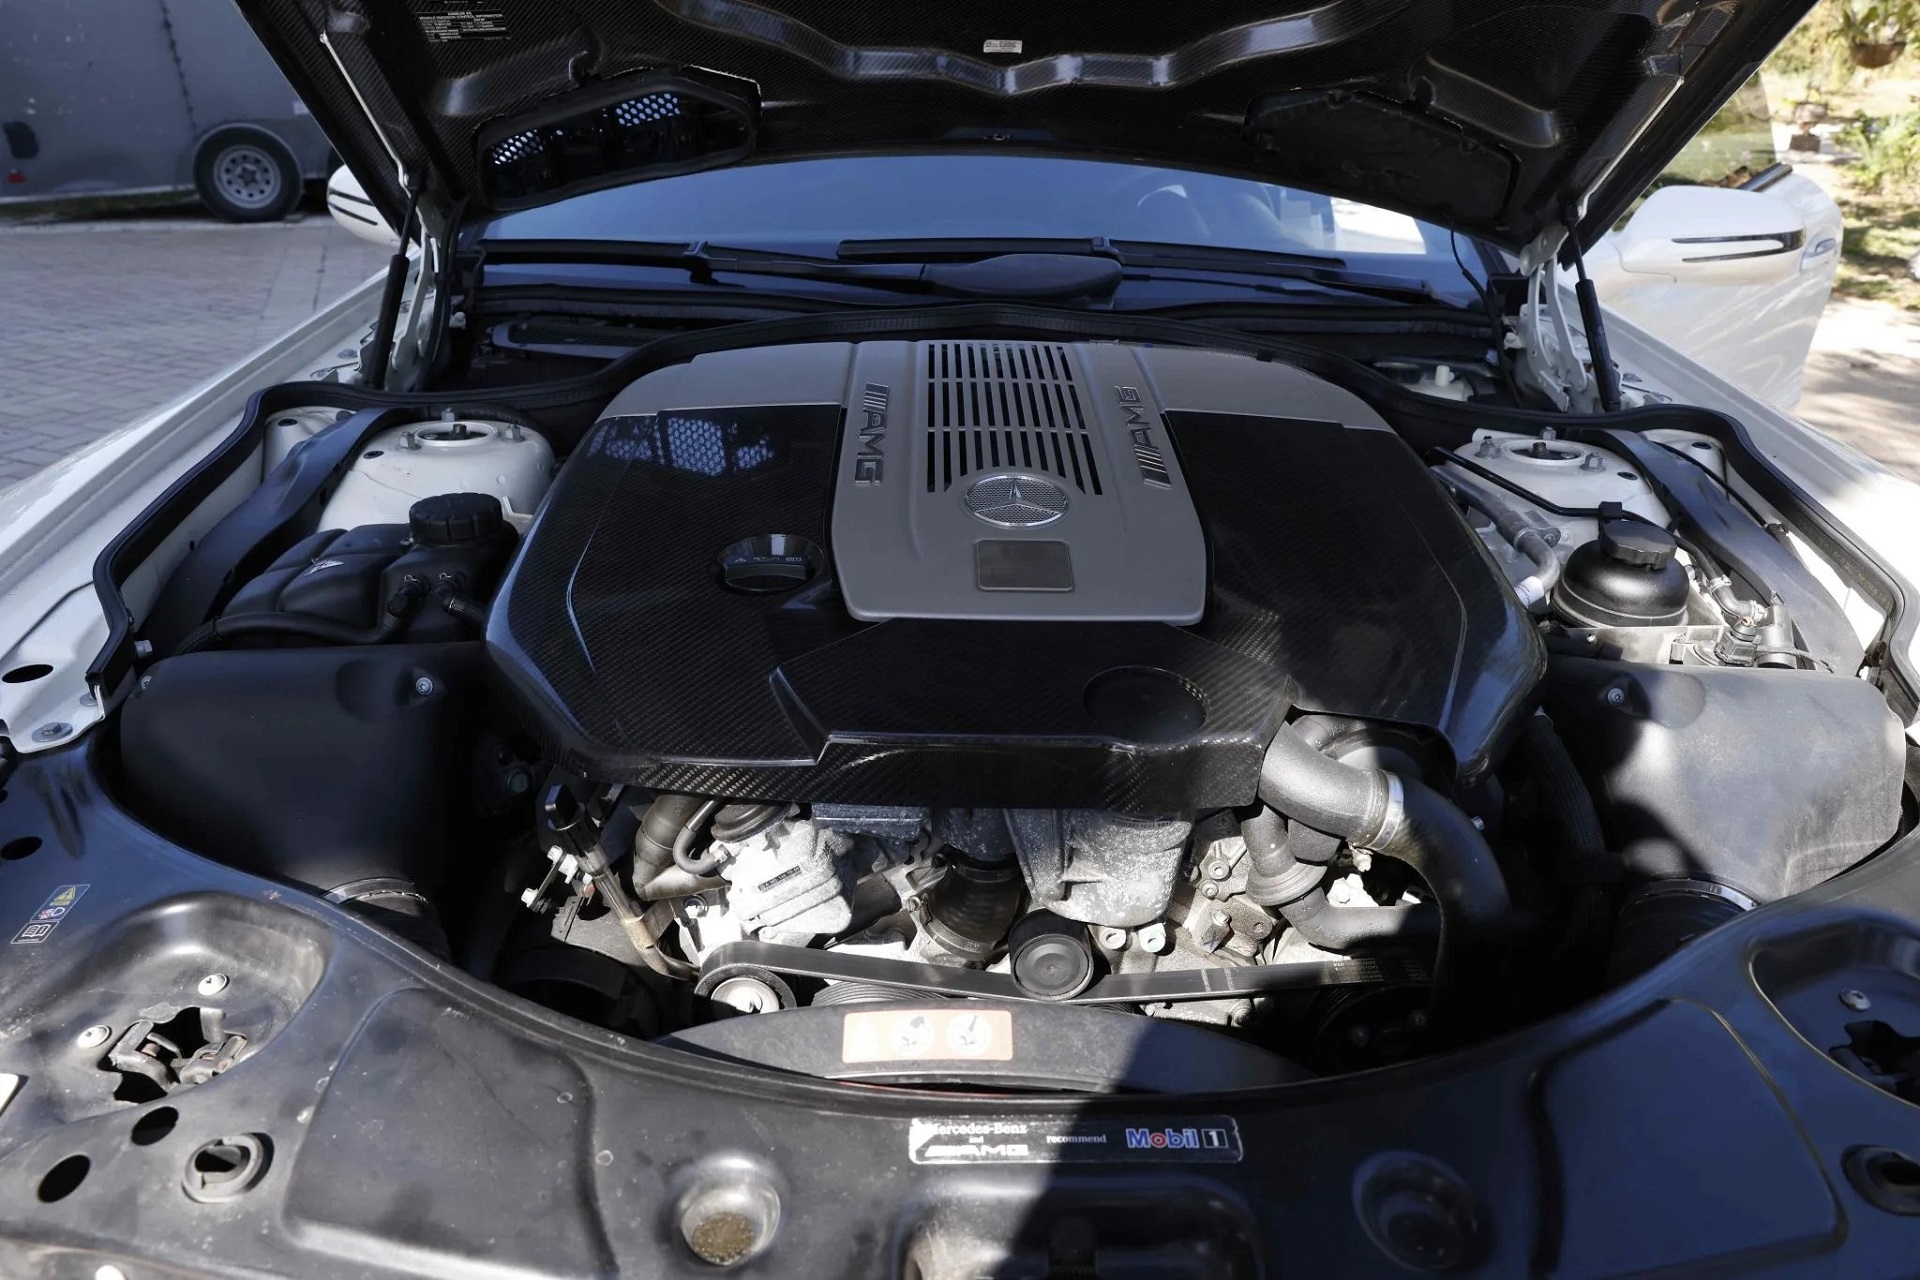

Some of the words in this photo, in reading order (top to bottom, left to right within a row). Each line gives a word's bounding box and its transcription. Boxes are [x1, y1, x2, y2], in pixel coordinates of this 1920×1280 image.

[968, 1135, 985, 1144] and
[1046, 1134, 1107, 1144] recommend
[1125, 1128, 1200, 1149] Mobil
